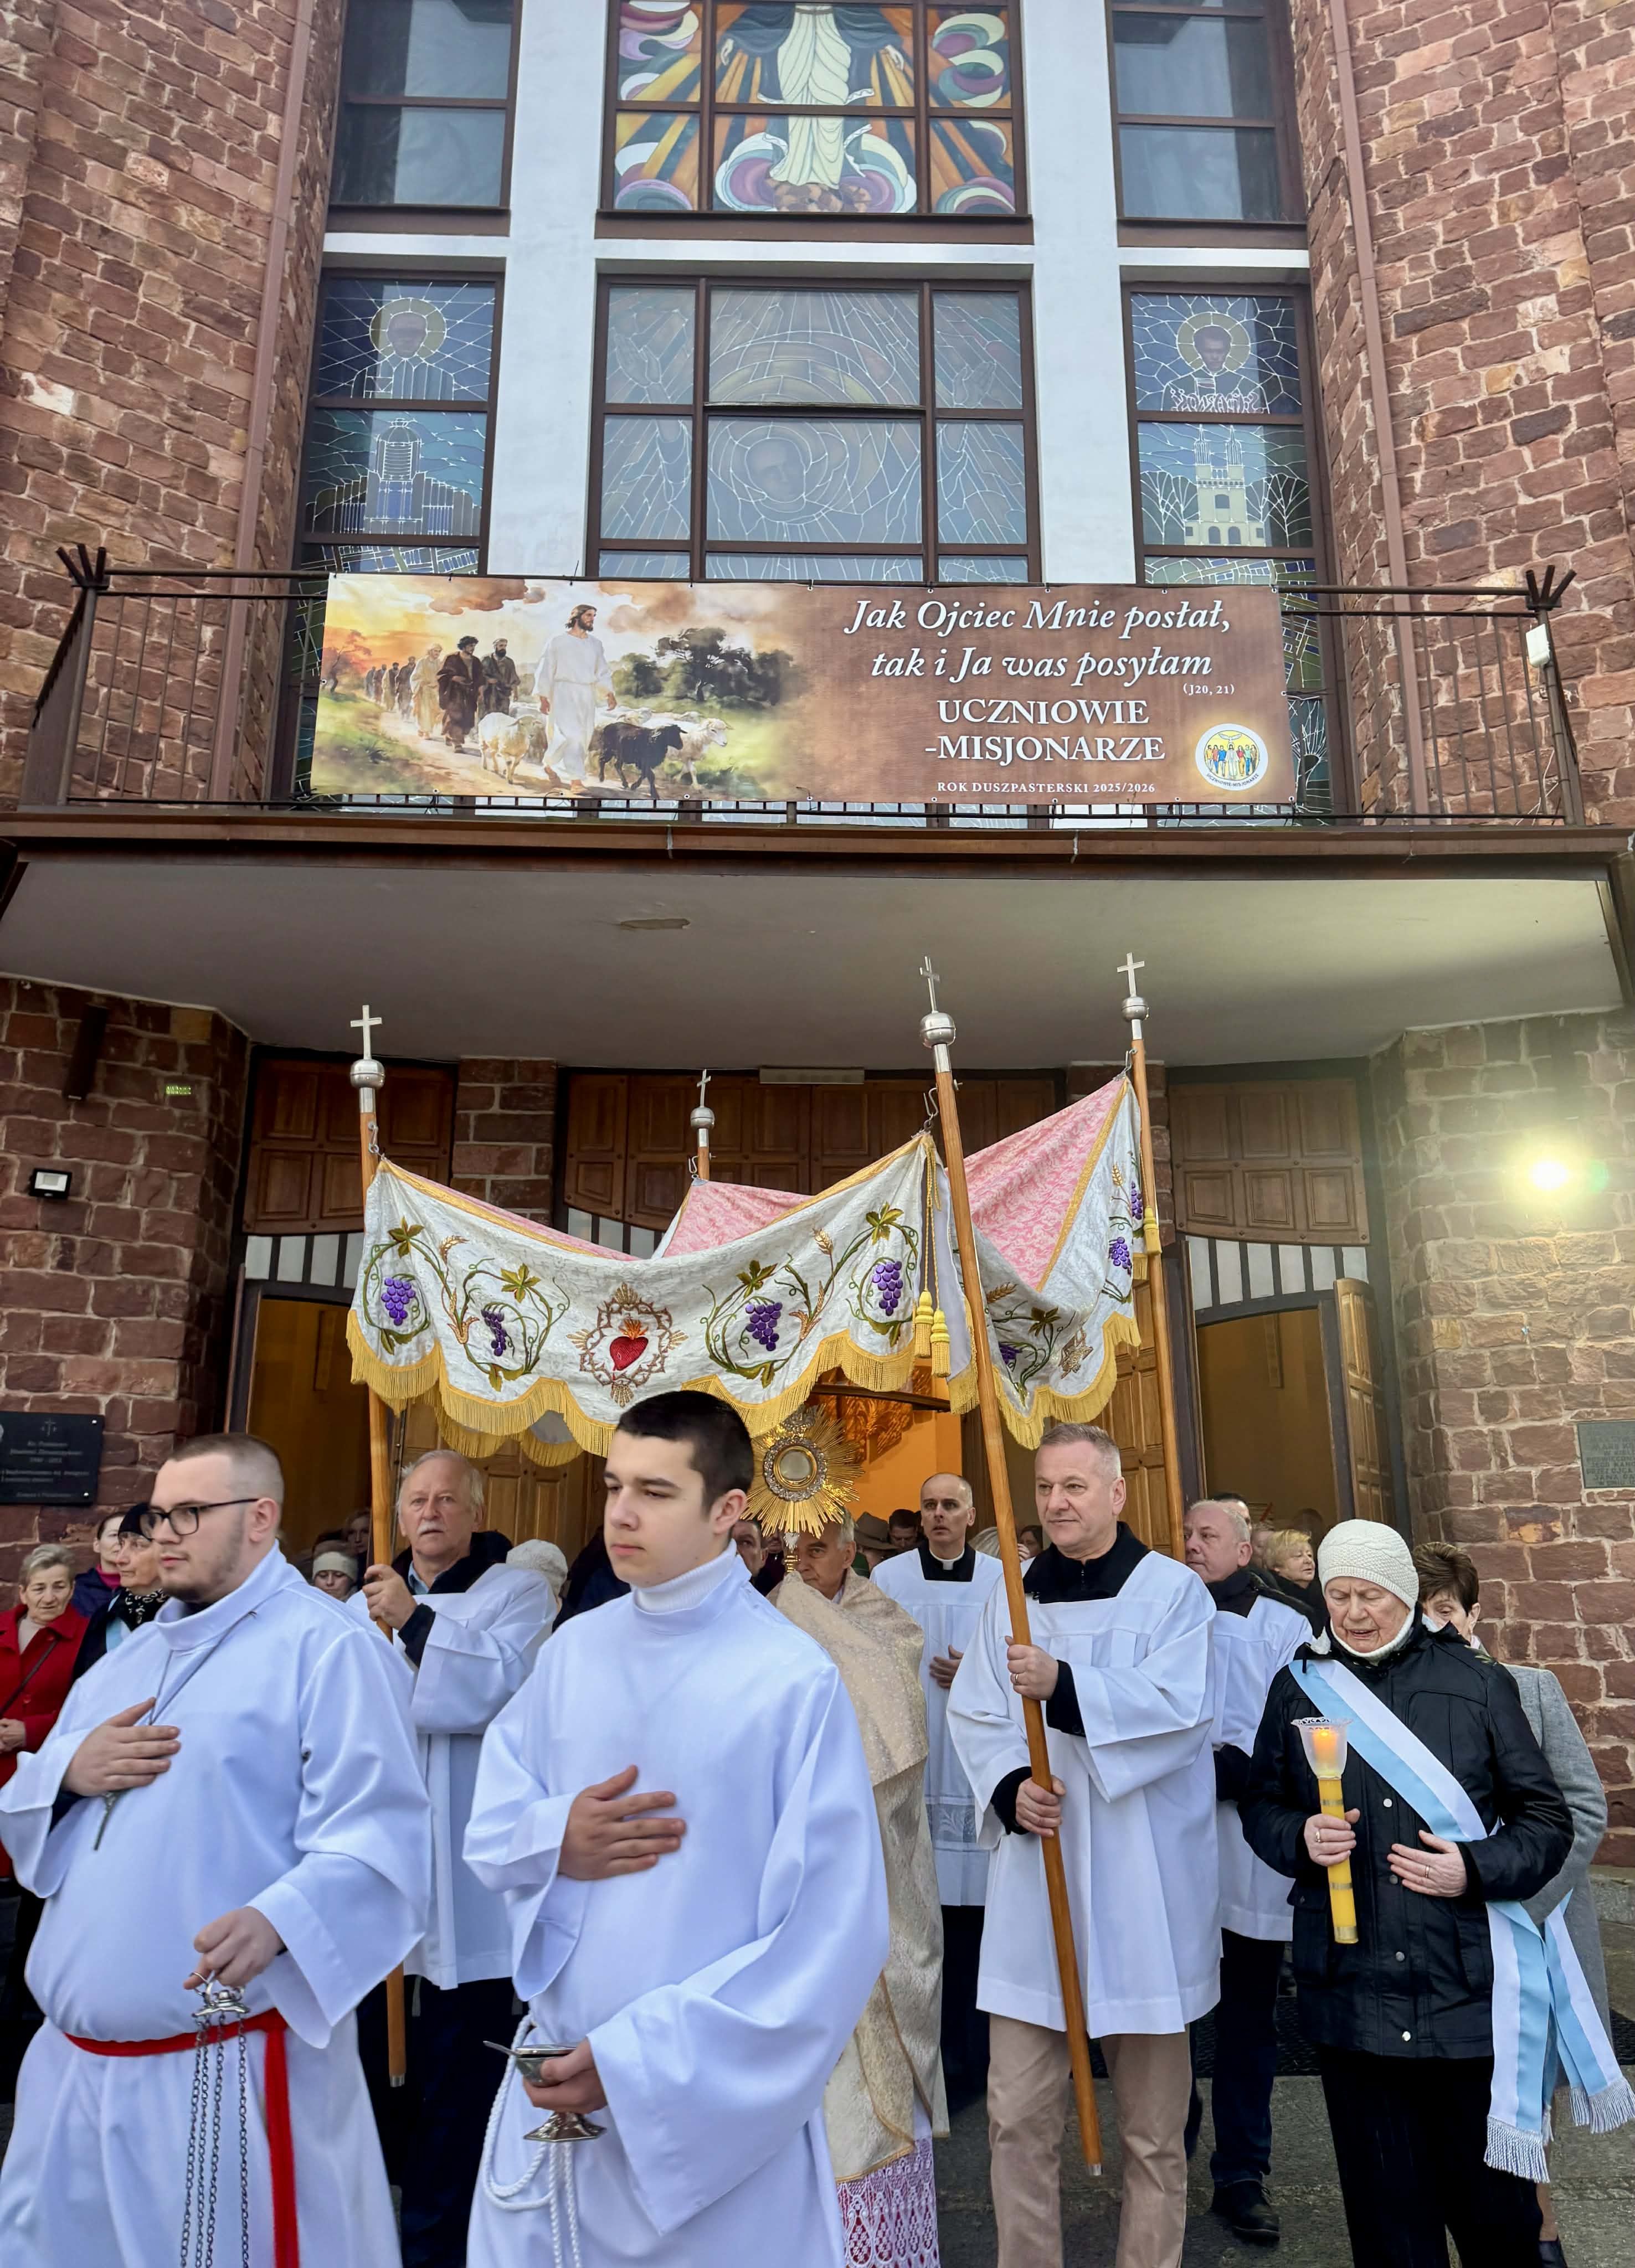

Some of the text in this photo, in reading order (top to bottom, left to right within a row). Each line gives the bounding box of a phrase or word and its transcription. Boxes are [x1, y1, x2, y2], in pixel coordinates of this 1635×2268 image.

[844, 600, 1230, 639] Jak Ojciec Mnie posłał,
[871, 646, 1212, 687] tak i Ja was posyłam
[1182, 683, 1235, 695] (J20, 21)
[937, 698, 1150, 724] UCZNIOWIE
[925, 735, 1165, 766] -MISJONARZE
[937, 782, 1155, 793] ROK DUSZPASTERSKI 2025/2026
